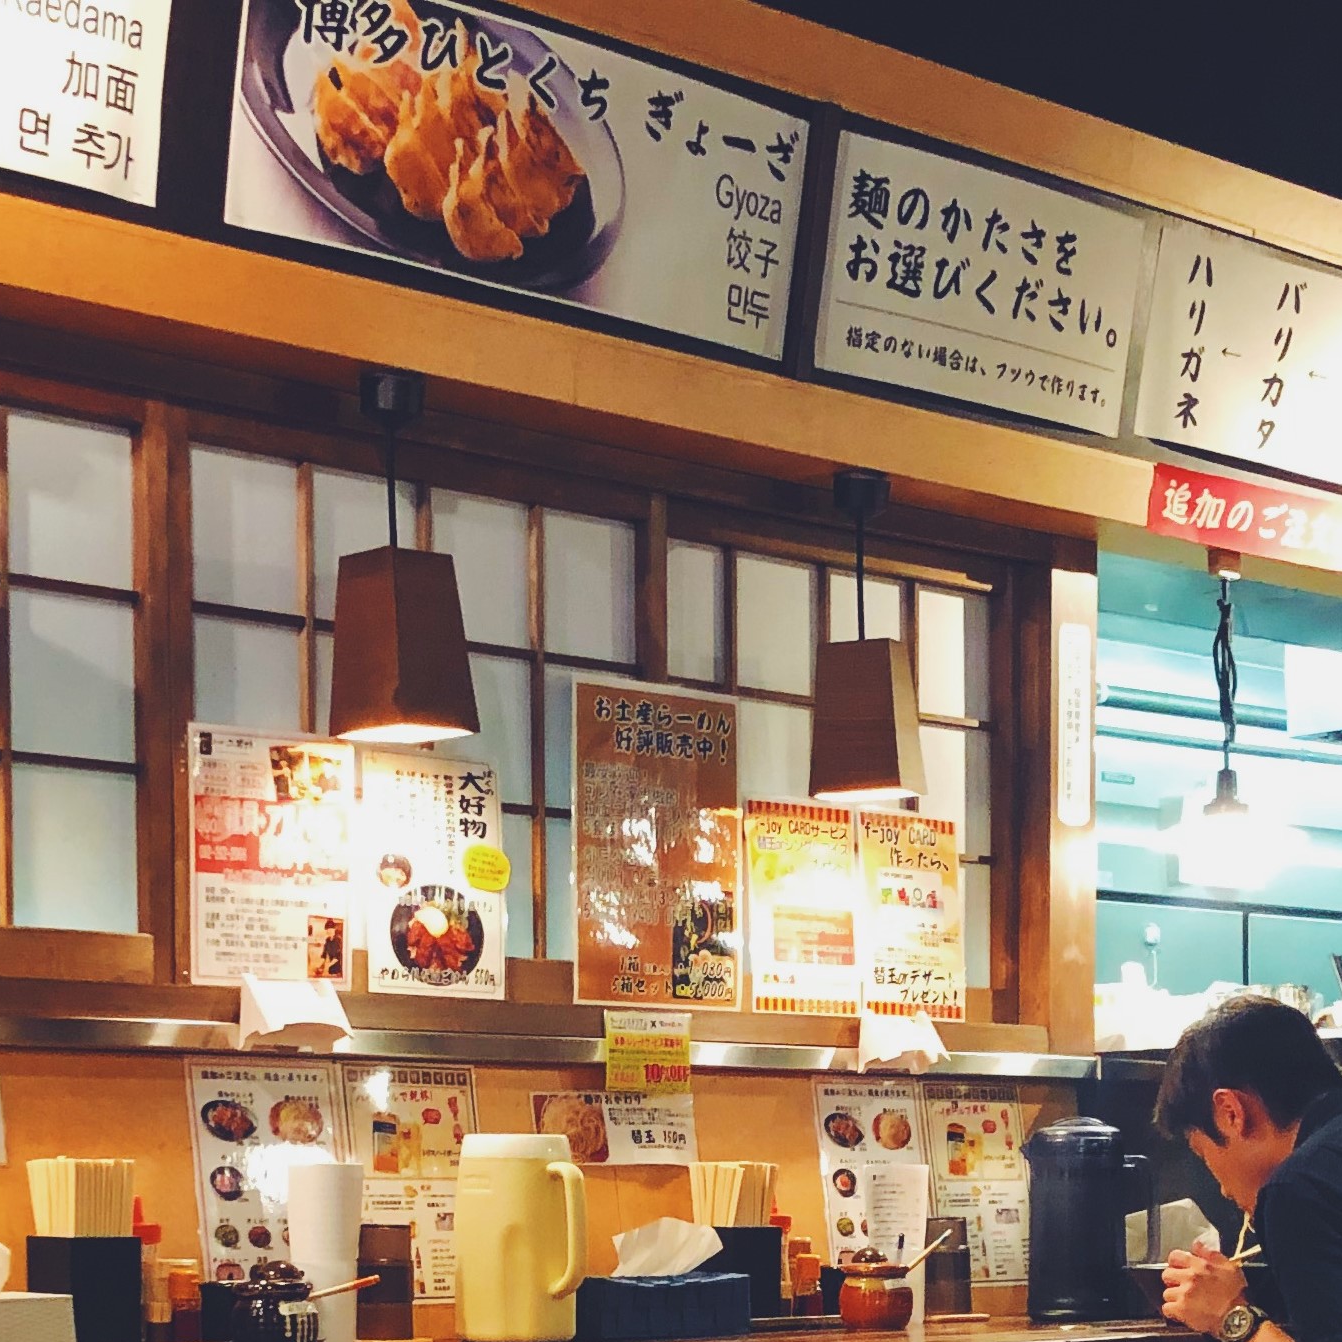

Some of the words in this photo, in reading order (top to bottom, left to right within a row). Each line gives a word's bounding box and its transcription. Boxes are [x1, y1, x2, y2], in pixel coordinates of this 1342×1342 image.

[62, 51, 138, 115] 加面
[19, 107, 51, 157] 면
[72, 123, 134, 180] 추가
[715, 173, 783, 226] Gyoza
[847, 168, 1079, 278] 麺のかたさを
[725, 228, 780, 280] 饺子
[726, 285, 770, 330] 만두
[845, 234, 1118, 349] お選びください。
[847, 325, 1107, 408] 指定のない場合は、フツウで作ります。
[1173, 254, 1214, 429] ハリガネ
[1256, 281, 1309, 450] バリカタ
[595, 696, 733, 736] お土産らーめん
[615, 726, 730, 764] 好評販売中!
[458, 771, 488, 840] 大好物
[865, 821, 901, 846] f-joy
[908, 826, 938, 847] CARD
